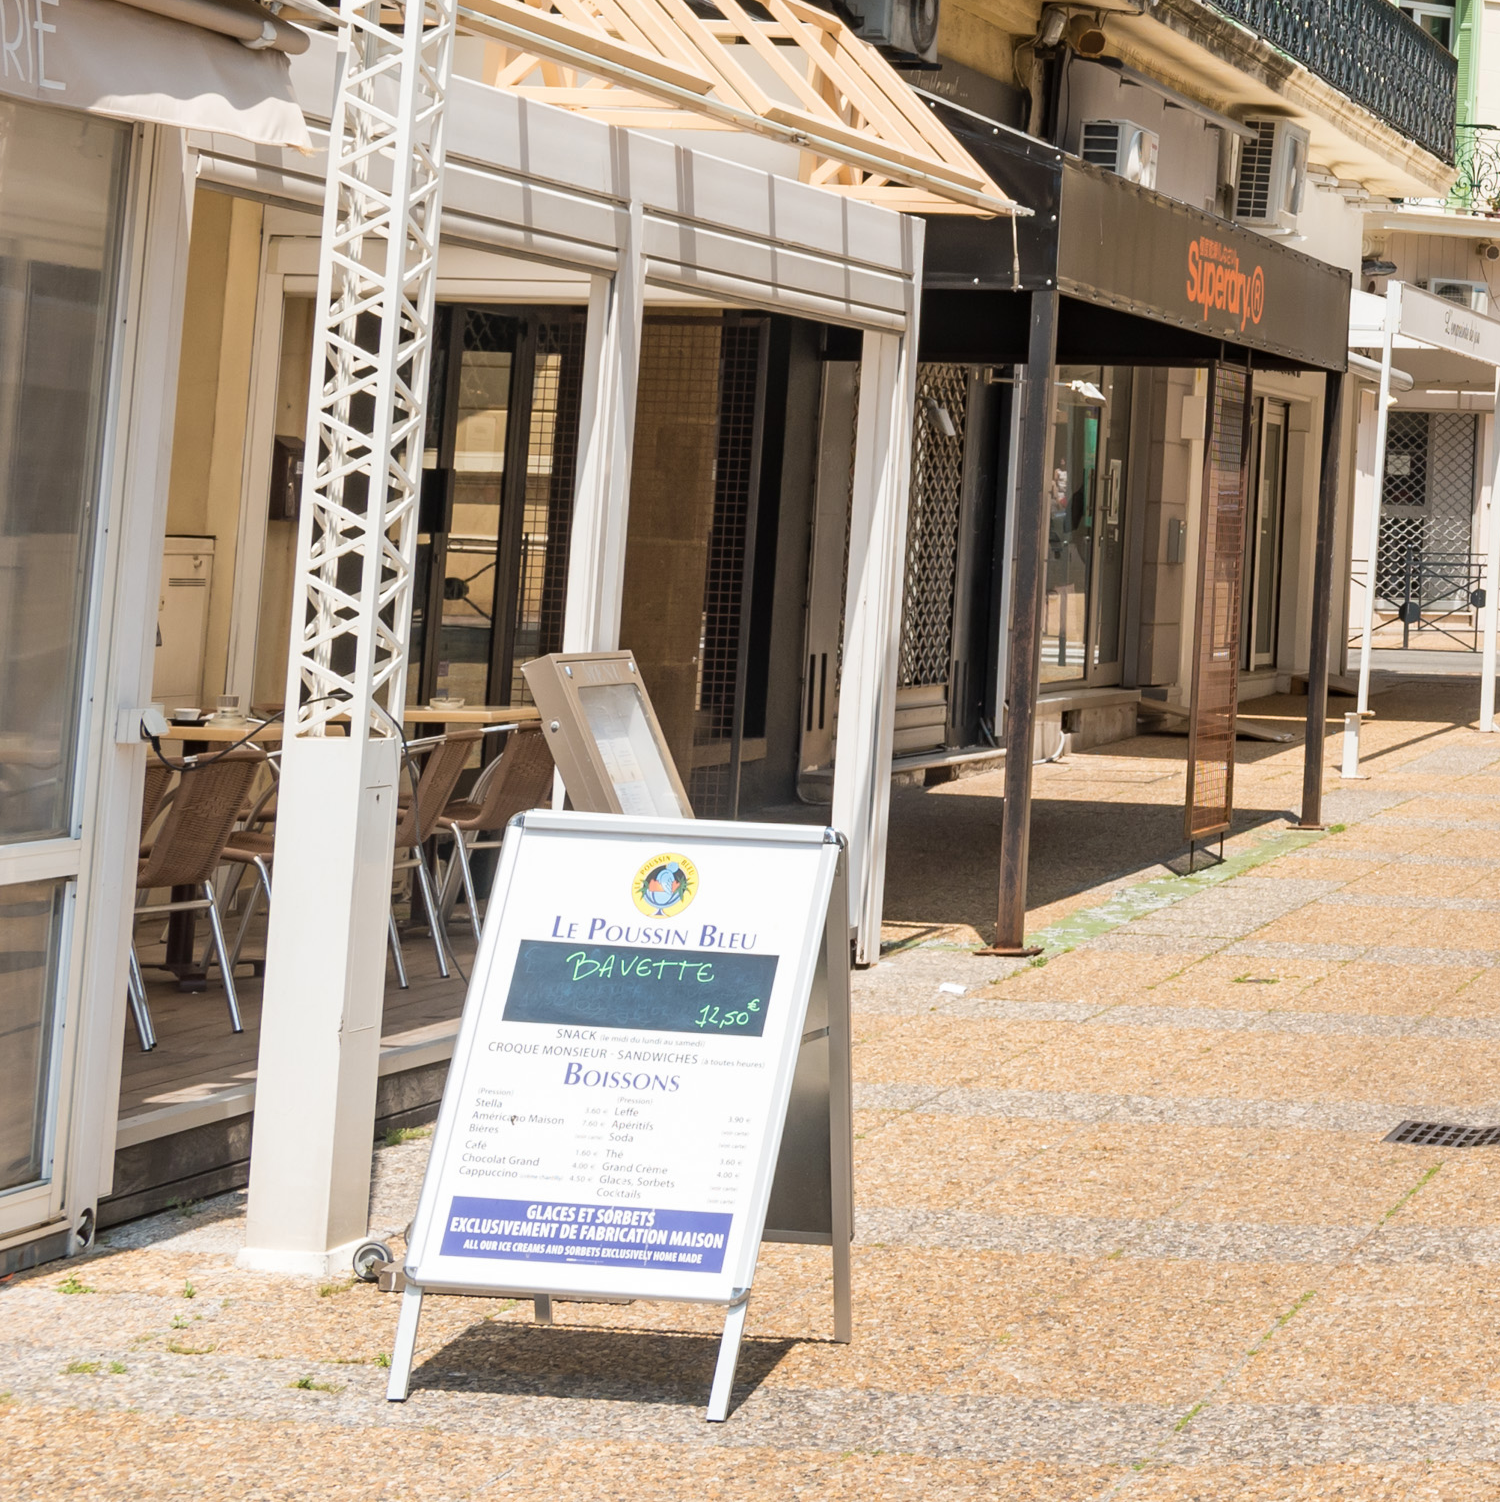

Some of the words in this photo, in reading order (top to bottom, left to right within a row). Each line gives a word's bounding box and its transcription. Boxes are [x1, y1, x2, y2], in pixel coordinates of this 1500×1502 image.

[640, 855, 671, 876] POUSSIN
[681, 859, 695, 877] BLEU
[588, 918, 688, 945] POUSSIN
[699, 924, 757, 950] BLEU
[566, 951, 715, 982] BAVETTE
[556, 1028, 597, 1041] SNACK
[611, 1035, 629, 1043] midi
[630, 1036, 640, 1044] du
[641, 1036, 662, 1045] lundi
[674, 1038, 706, 1048] samedi)
[487, 1041, 540, 1055] CROQUE
[542, 1045, 608, 1060] MONSIEUR
[617, 1049, 699, 1065] SANDWICHES
[710, 1058, 732, 1067] toutes
[733, 1060, 766, 1070] heures)
[563, 1062, 681, 1093] BOISSONS
[478, 1087, 514, 1097] (Pression)
[475, 1098, 503, 1108] Stella
[617, 1096, 653, 1106] (Pression)
[614, 1107, 639, 1117] Leffe
[528, 1114, 565, 1125] Maison
[612, 1120, 654, 1131] Apéritifs
[609, 1133, 634, 1143] Soda
[465, 1140, 487, 1150] Café
[462, 1153, 505, 1164] Chocolat
[508, 1156, 540, 1166] Grand
[606, 1149, 624, 1159] Thé
[459, 1165, 518, 1178] Cappuccino
[602, 1162, 633, 1173] Grand
[635, 1164, 668, 1175] Crème
[599, 1175, 634, 1186] Glaces,
[636, 1177, 675, 1188] Sorbets
[596, 1188, 641, 1199] Cocktails
[526, 1204, 576, 1222] GLACES
[578, 1208, 595, 1223] ET
[597, 1209, 655, 1226] SORBETS
[450, 1217, 559, 1239] EXCLUSIVEMENT
[560, 1224, 577, 1239] DE
[579, 1225, 669, 1245] FABRICATION
[669, 1231, 724, 1249] MAISON
[463, 1239, 478, 1250] ALL
[480, 1240, 497, 1251] OUR
[498, 1241, 511, 1252] ICE
[512, 1242, 545, 1254] CREAMS
[546, 1244, 563, 1255] AND
[565, 1245, 600, 1257] SORBETS
[601, 1247, 652, 1261] EXCLUSIVELY
[653, 1251, 677, 1262] HOME
[678, 1252, 703, 1264] MADE
